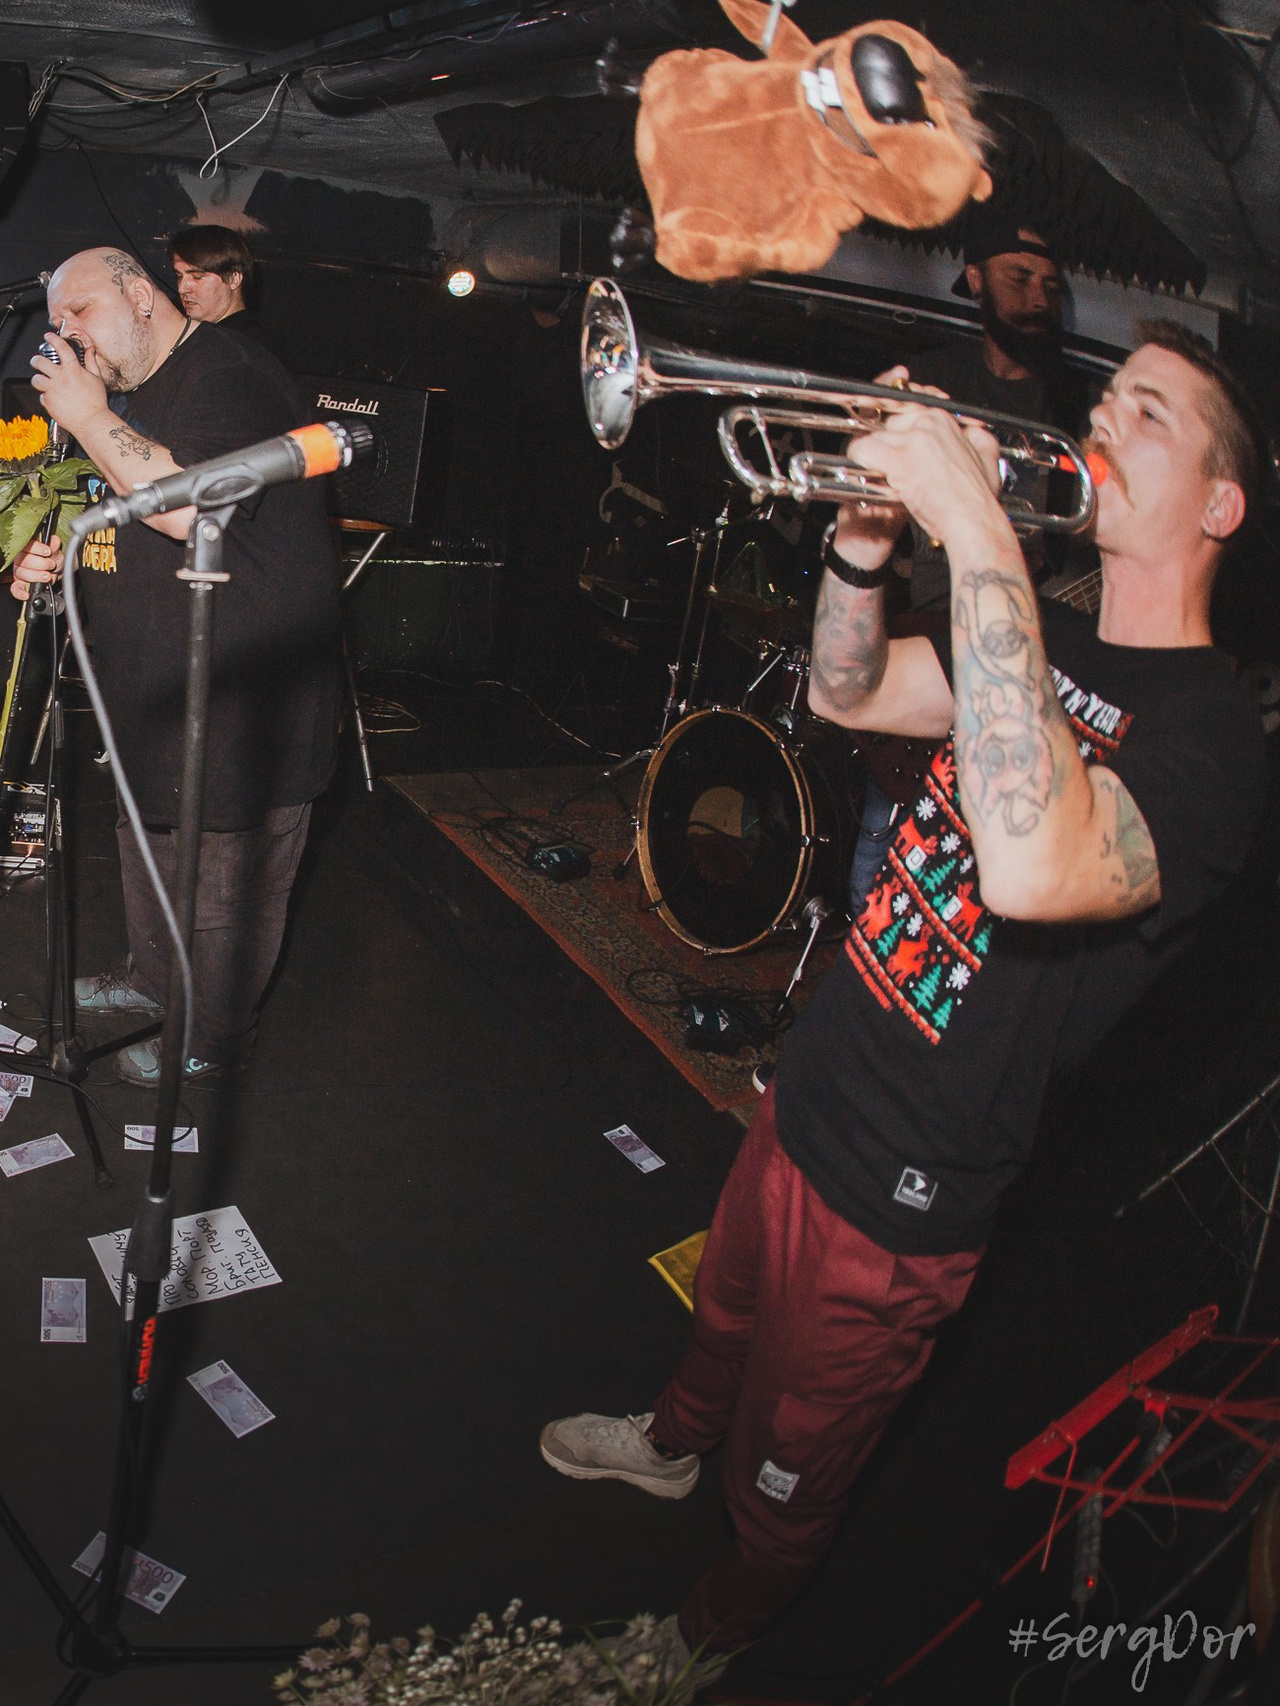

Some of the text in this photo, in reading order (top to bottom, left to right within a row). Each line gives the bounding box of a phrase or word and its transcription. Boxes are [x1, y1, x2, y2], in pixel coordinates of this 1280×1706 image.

[316, 393, 379, 416] Randall
[4, 1074, 27, 1084] 500
[235, 1228, 276, 1280] ПЕНСИЯ
[143, 1560, 175, 1584] 500
